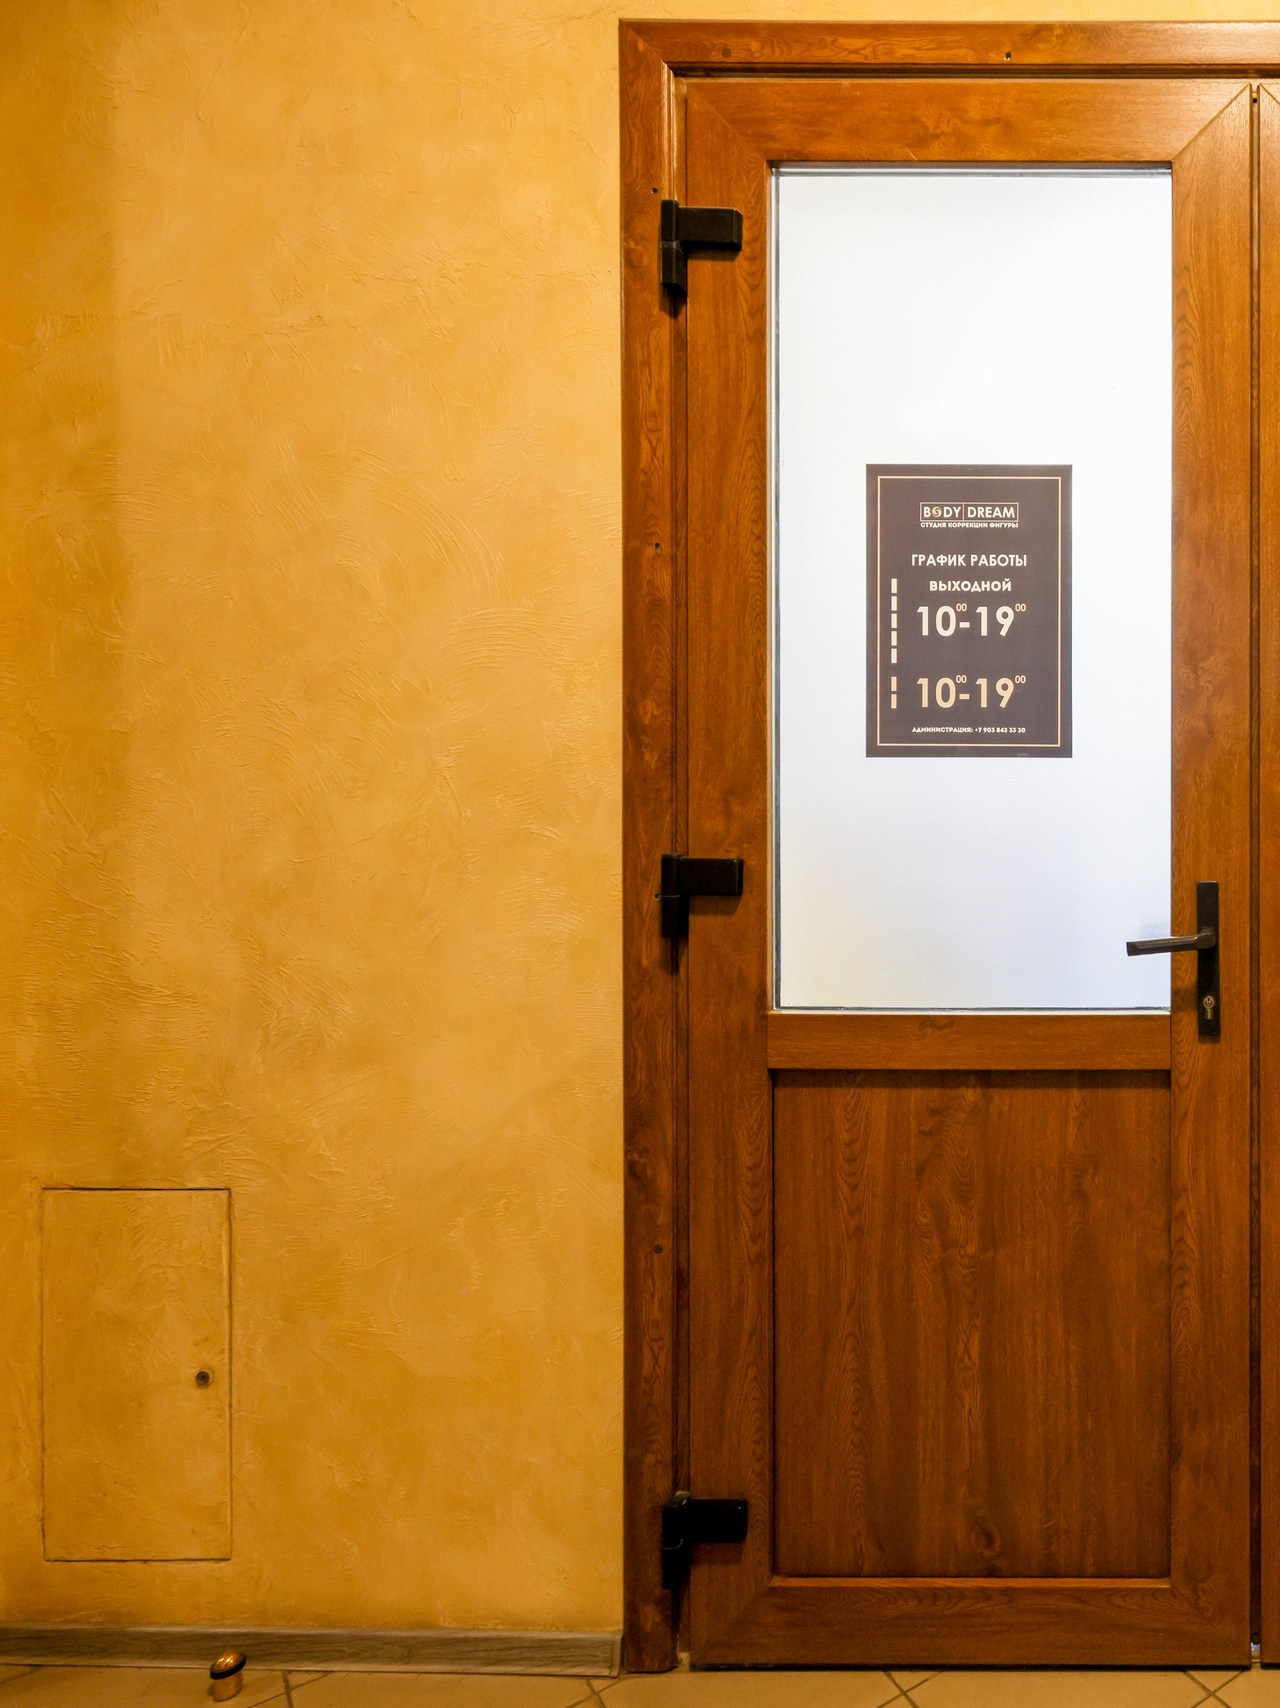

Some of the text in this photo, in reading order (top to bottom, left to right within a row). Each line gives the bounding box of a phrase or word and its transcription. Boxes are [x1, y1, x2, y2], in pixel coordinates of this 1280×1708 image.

[923, 506, 1016, 518] BODY DREAM
[911, 554, 1027, 567] ГРАФИК РАБОТЫ
[929, 578, 1012, 592] ВЫХОДНОЙ
[911, 726, 974, 734] АДМИНИСТРАЦИЯ:
